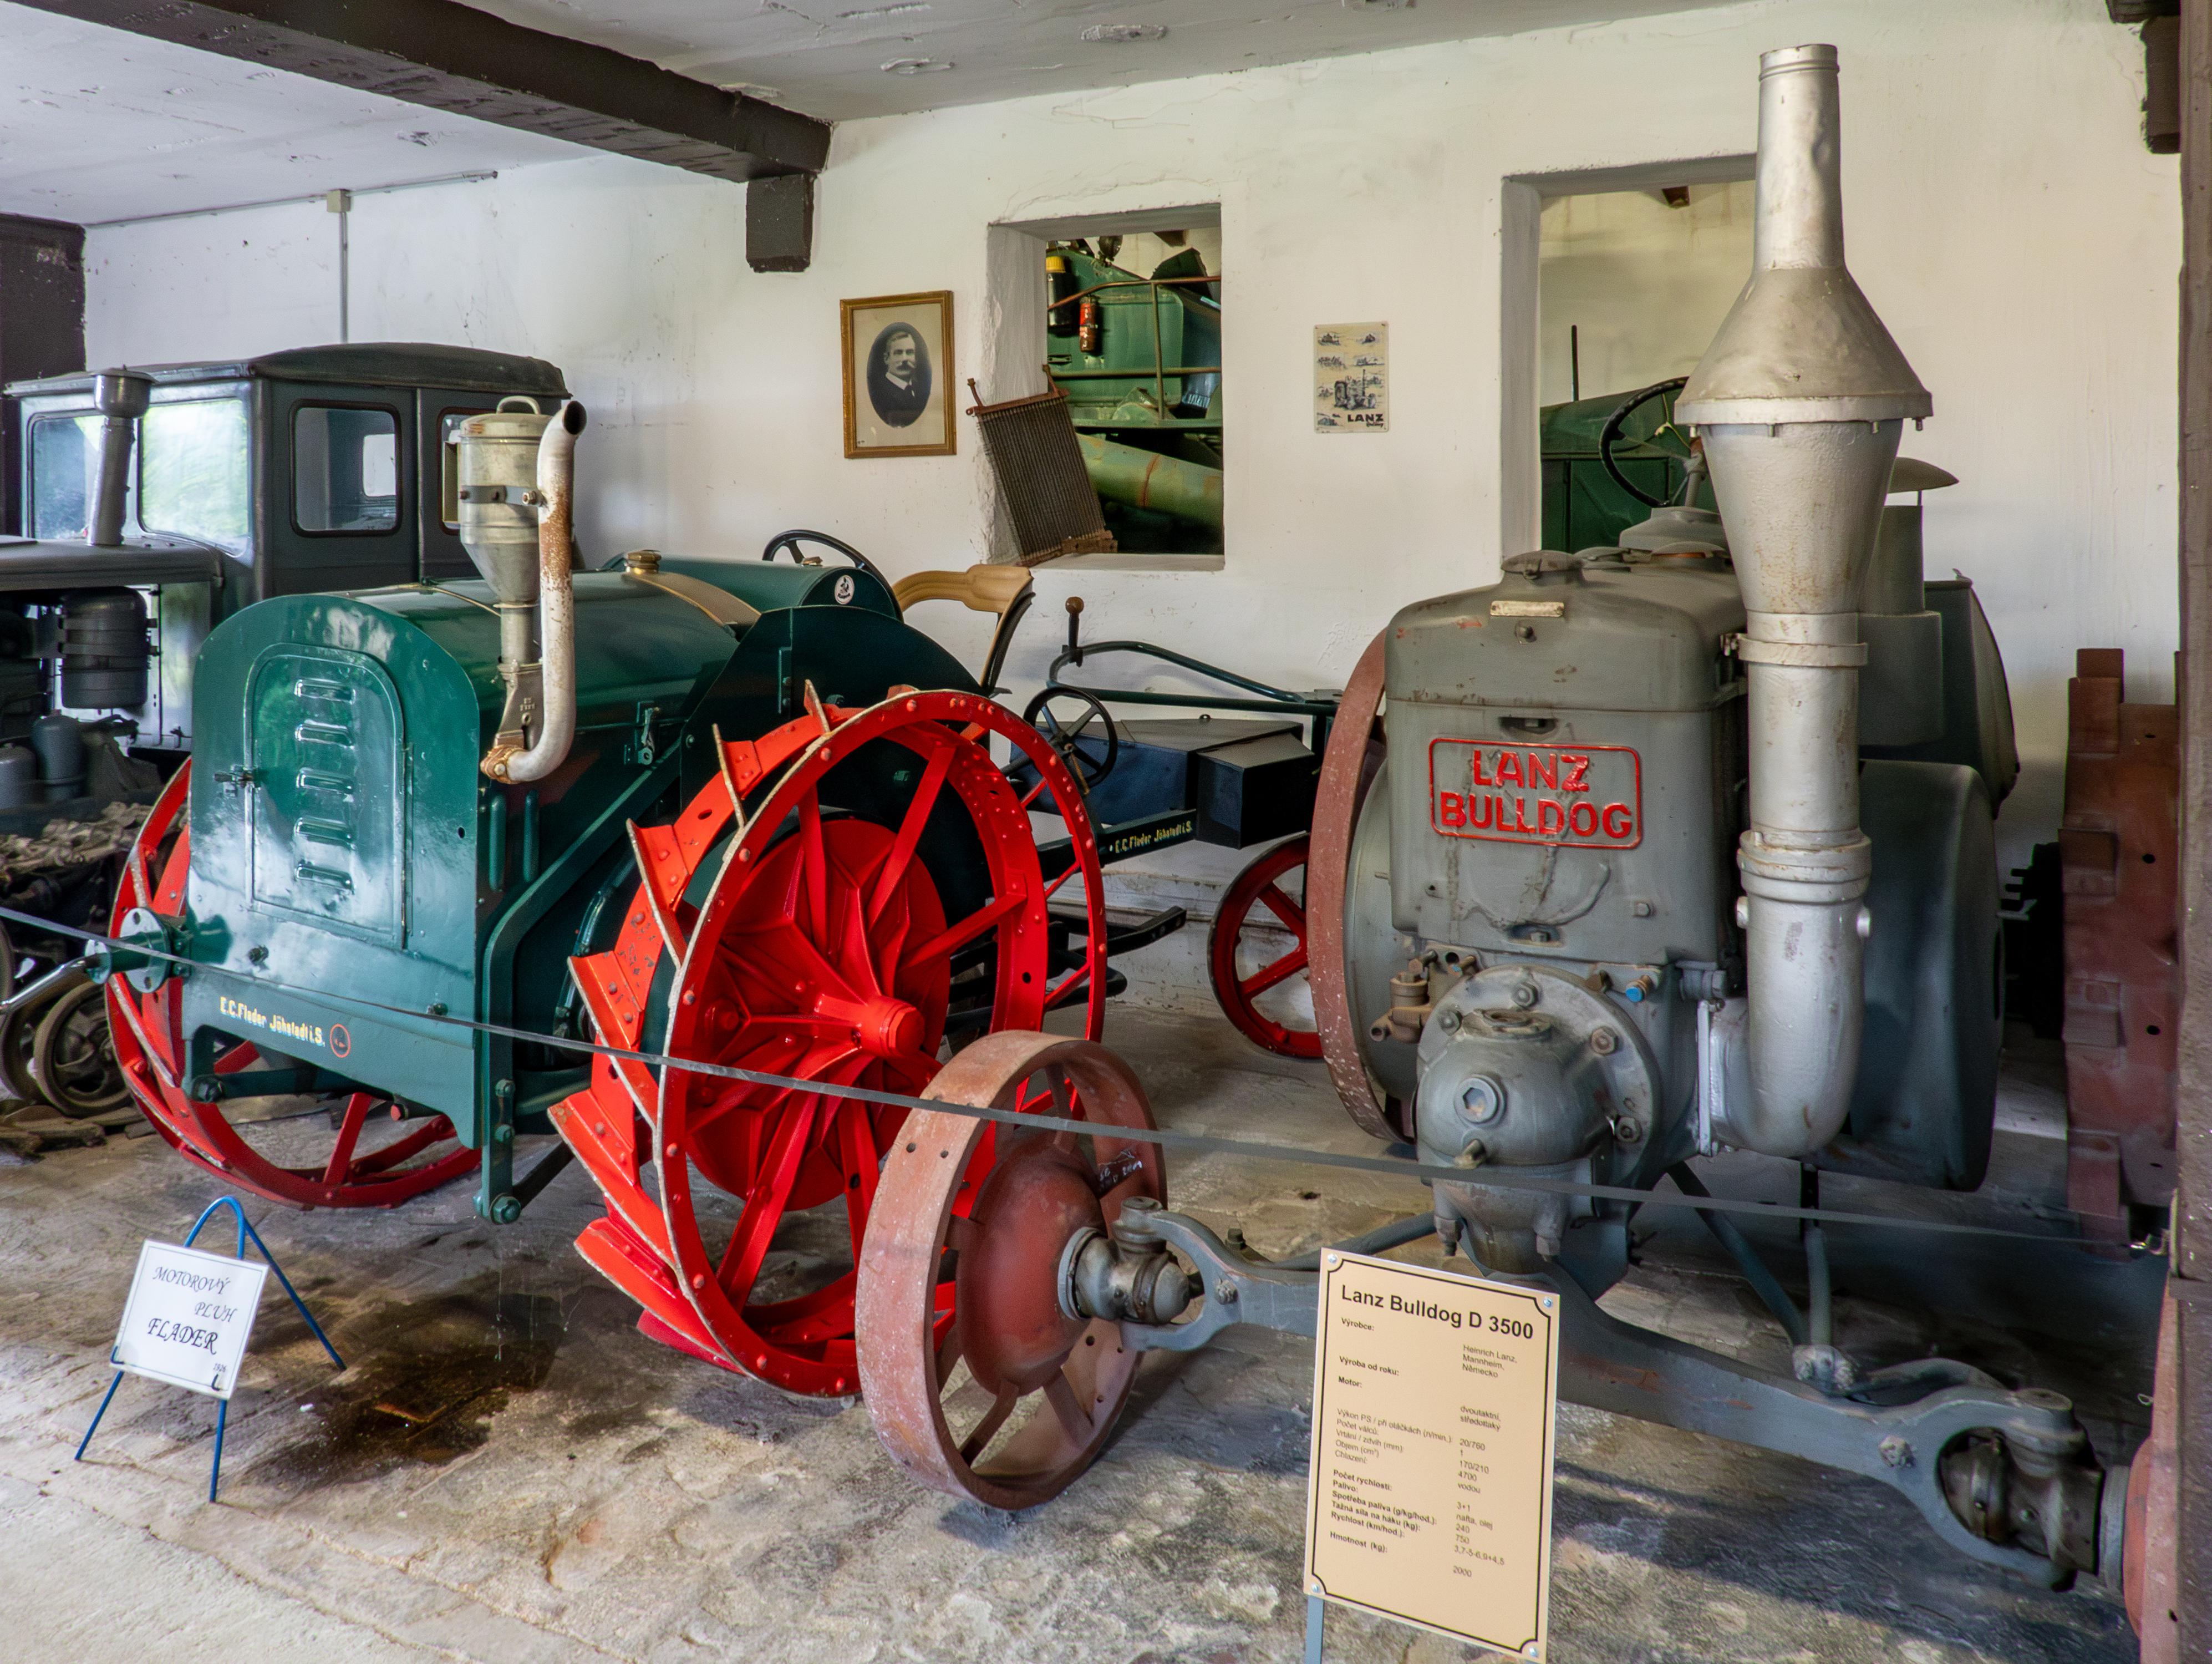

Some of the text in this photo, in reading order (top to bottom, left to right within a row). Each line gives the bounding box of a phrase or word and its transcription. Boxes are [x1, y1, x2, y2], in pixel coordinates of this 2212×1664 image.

[1347, 414, 1384, 422] LANZ
[1473, 749, 1589, 792] LANZ
[1440, 791, 1632, 838] BULLDOG
[152, 1266, 231, 1295] MOTOROVÝ
[194, 1302, 237, 1323] PLUH
[1341, 1284, 1533, 1340] Lanz Bulldog D 3500
[1341, 1317, 1375, 1332] Výrobce:
[147, 1318, 218, 1354] FLADER
[1463, 1344, 1494, 1357] Heinrich
[1339, 1356, 1399, 1376] Výroba od roku:
[1463, 1354, 1504, 1370] Mannheim,
[1462, 1363, 1498, 1378] Německo
[1338, 1376, 1362, 1388] Motor:
[1337, 1408, 1359, 1421] Výkon
[1361, 1414, 1371, 1423] PS
[1336, 1419, 1356, 1430] Počet
[1335, 1439, 1359, 1451] Objem
[1362, 1436, 1382, 1447] zdvih
[1460, 1438, 1486, 1451] 20/760
[1459, 1460, 1489, 1474] 170/210
[1333, 1469, 1355, 1482] Počet
[1458, 1471, 1477, 1482] 4700
[1333, 1479, 1358, 1493] Palivo:
[1457, 1483, 1481, 1494] vodou
[1332, 1490, 1366, 1506] Spotřeba
[1368, 1501, 1391, 1513] paliva
[1457, 1501, 1471, 1512] 3+1
[1331, 1511, 1364, 1527] Rychlost
[1332, 1500, 1353, 1513] Tažná
[1355, 1507, 1369, 1516] síla
[1382, 1514, 1401, 1526] háku
[1455, 1523, 1470, 1534] 240
[1330, 1531, 1367, 1548] Hmotnost
[1456, 1534, 1469, 1544] 750
[1453, 1565, 1472, 1577] 2000
